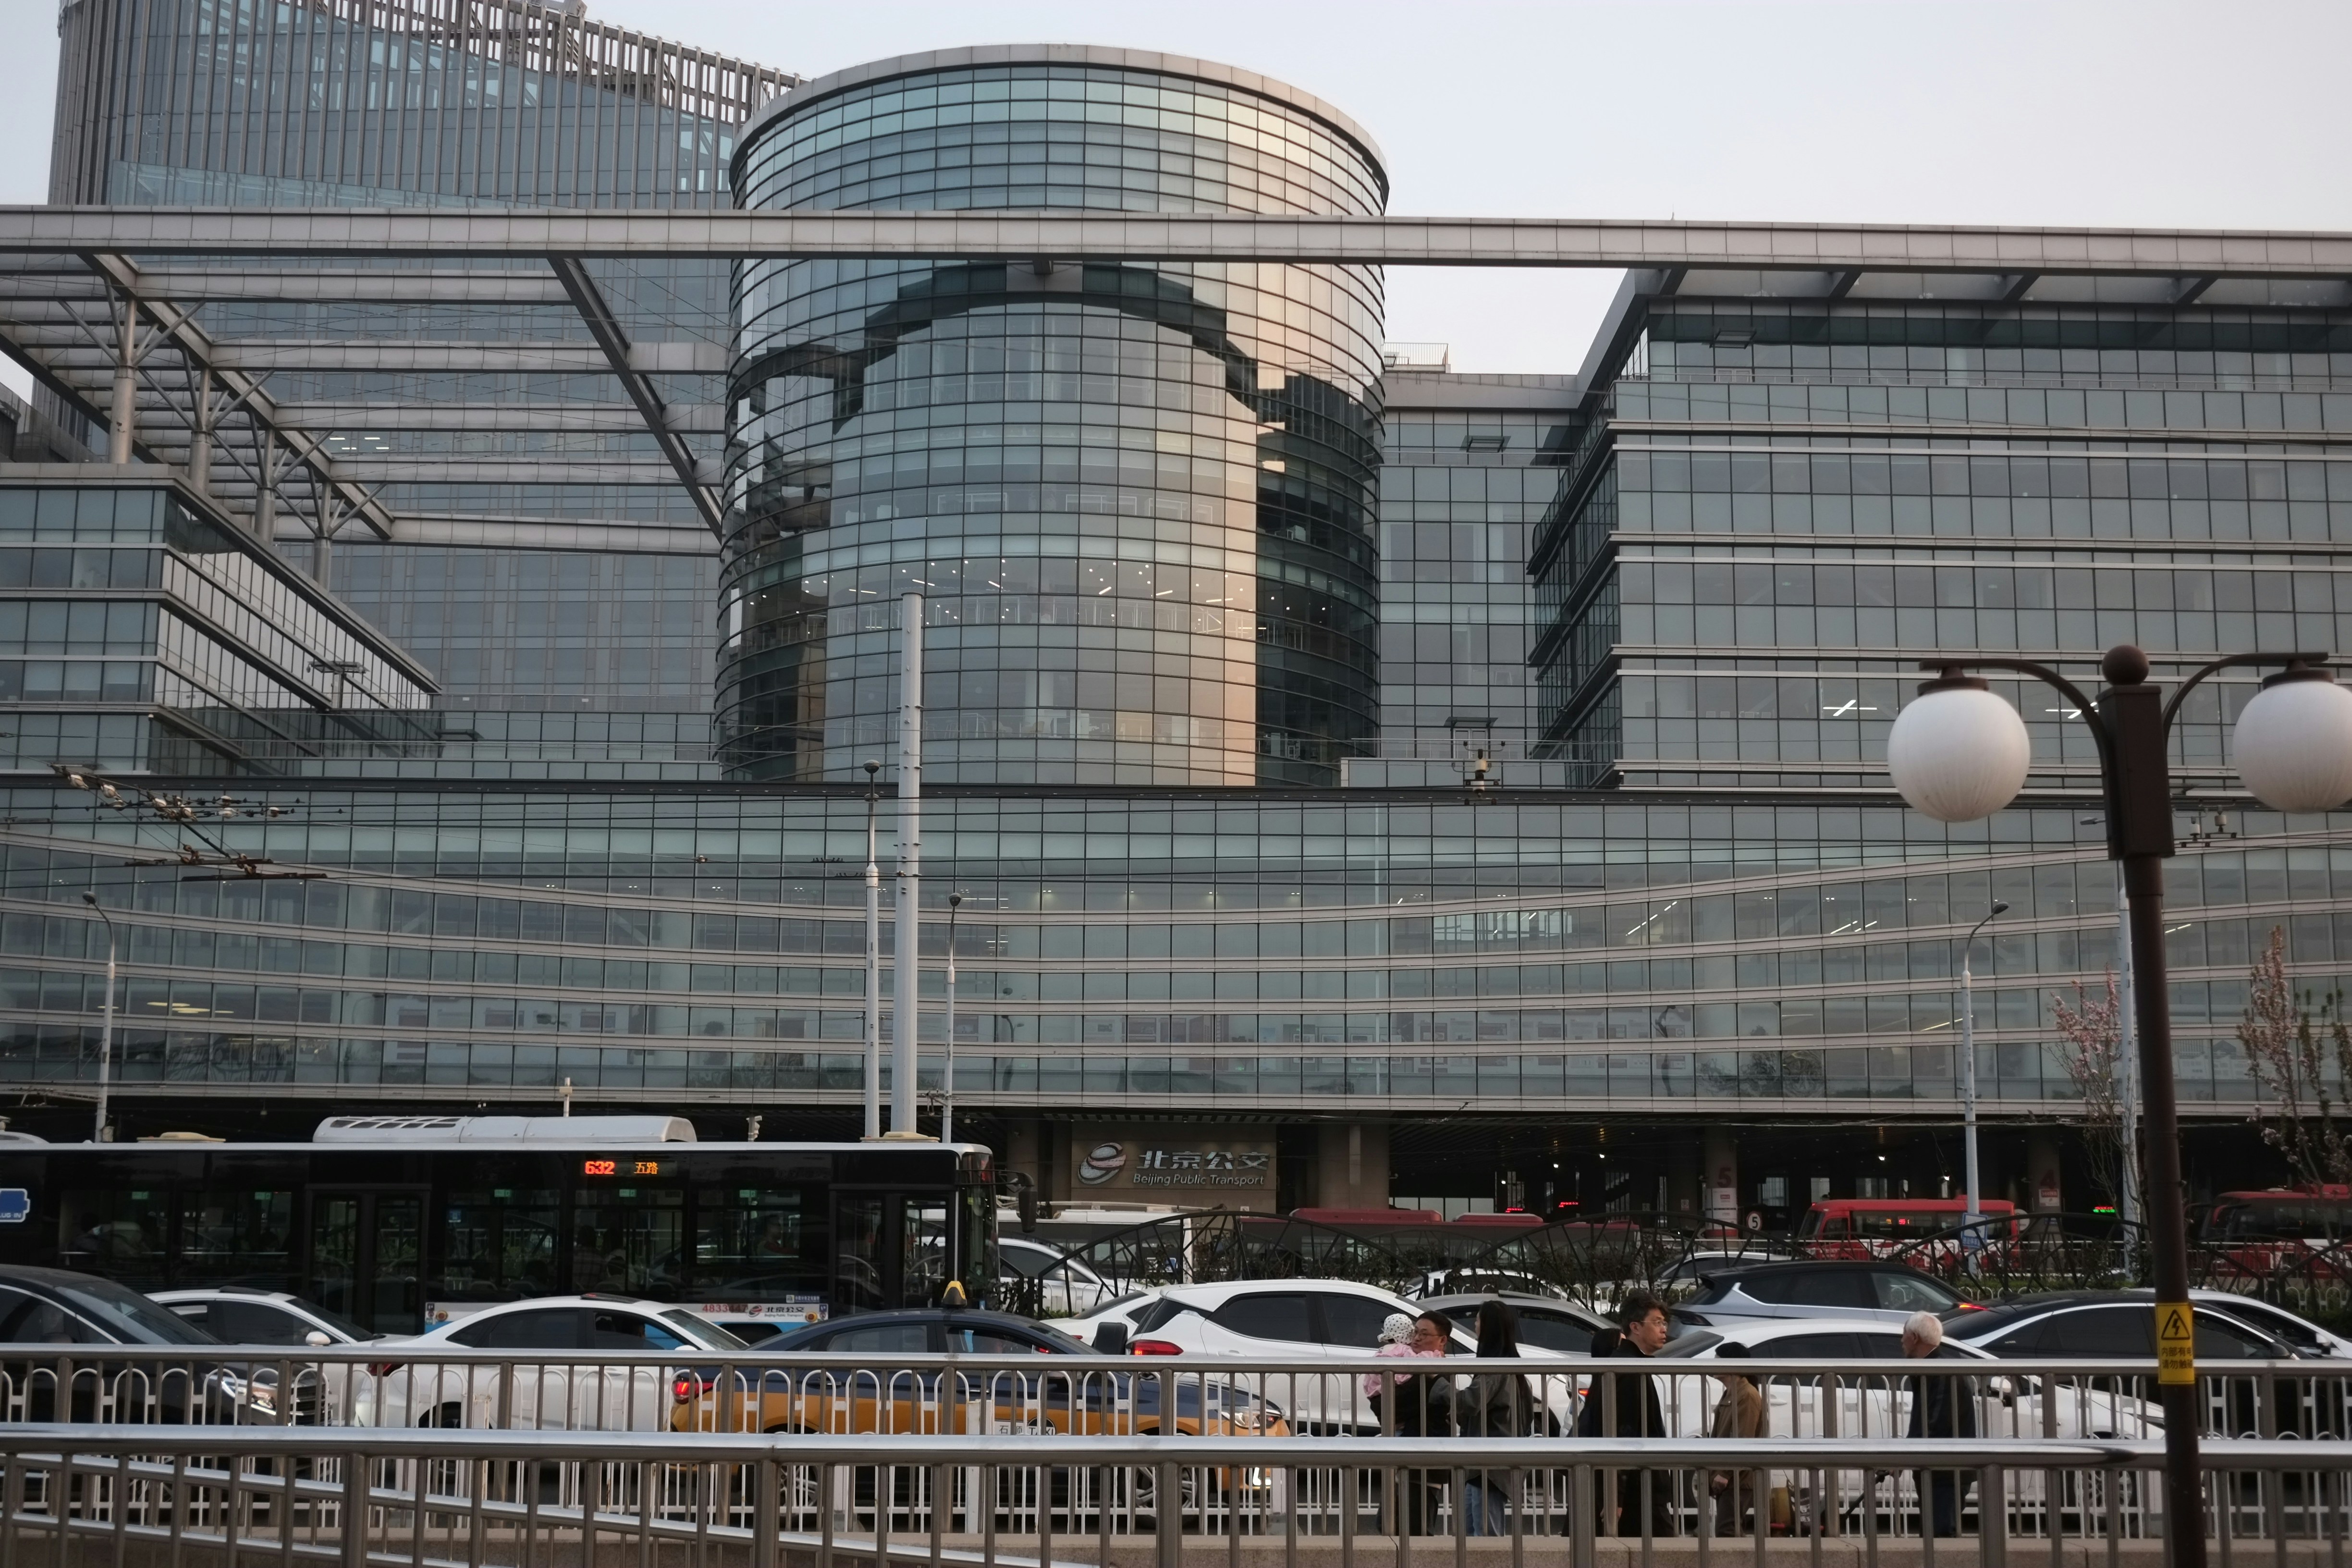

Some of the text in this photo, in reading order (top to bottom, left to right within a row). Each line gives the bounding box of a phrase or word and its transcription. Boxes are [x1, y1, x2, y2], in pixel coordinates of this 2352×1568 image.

[1136, 1151, 1270, 1169] 北京公交
[585, 1161, 615, 1175] 632
[634, 1162, 659, 1174] 五路
[1133, 1173, 1265, 1187] Beijing Public Transport
[1717, 1167, 1731, 1188] 5
[2040, 1169, 2056, 1189] 4
[1752, 1216, 1758, 1229] 5
[702, 1304, 748, 1312] 4833447
[2162, 1347, 2192, 1357] 内部有电
